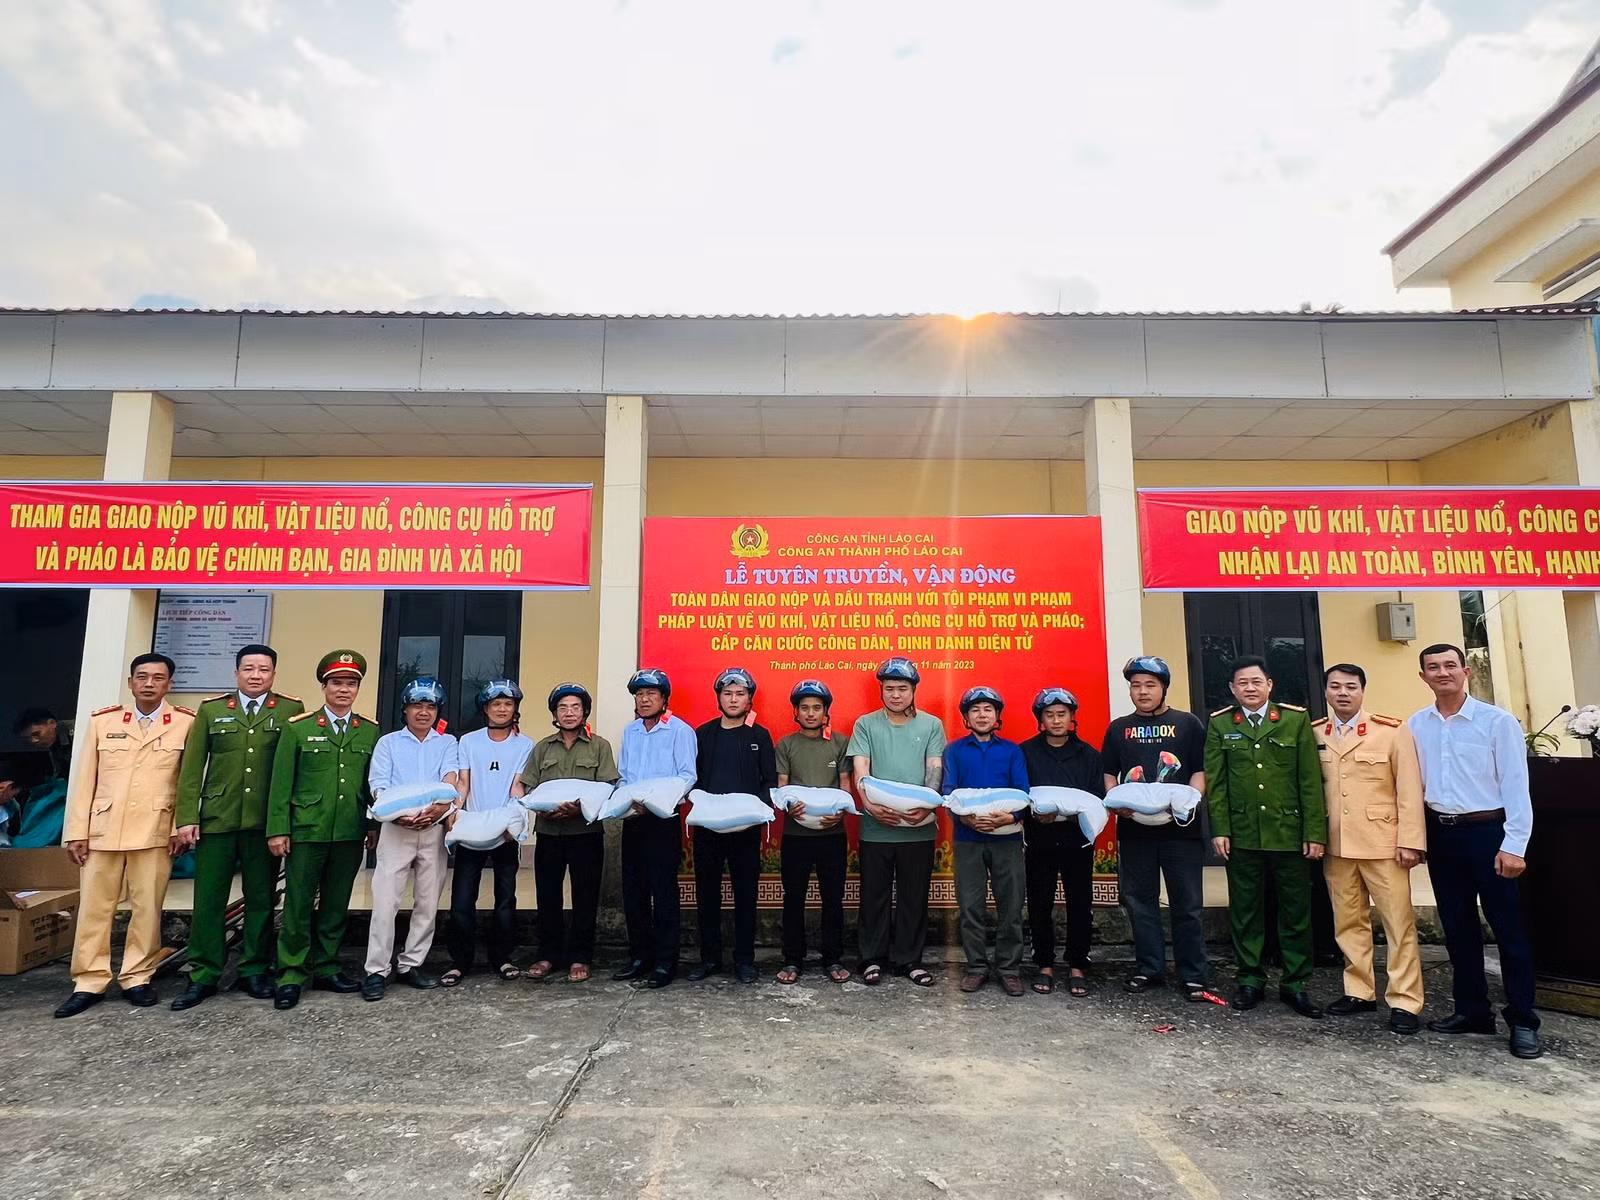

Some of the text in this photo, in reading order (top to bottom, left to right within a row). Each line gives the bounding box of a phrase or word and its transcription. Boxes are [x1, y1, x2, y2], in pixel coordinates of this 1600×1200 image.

[11, 497, 555, 536] THAM GIA GIAO NỘP VŨ KHÍ, VẬT LIỆU NỔ, CÔNG CỤ HỖ TRỢ
[1186, 500, 1600, 538] GIAO NỘP VŨ KHÍ, VẬT LIỆU NỔ, CÔNG C
[806, 532, 934, 543] CÔNG AN TỈNH LÀO CAI
[37, 537, 521, 578] VÀ PHÁO LÀ BẢO VỆ CHÍNH BẠN, GIA ĐÌNH VÀ XÃ HỘI
[778, 544, 962, 556] CÔNG AN THÀNH PHỐ LÀO CAI
[725, 561, 1016, 587] LỄ TUYÊN TRUYỀN, VẬN ĐỘNG
[1219, 546, 1600, 580] NHẬN LẠI AN TOÀN, BÌNH YÊN, HẠNH
[671, 588, 1071, 609] TOÀN DÂN GIAO NỘP VÀ ĐẤU TRANH VỚI TỘI PHẠM VI PHẠM
[659, 609, 1084, 632] PHÁP LUẬT VỀ VŨ KHÍ, VẬT LIỆU NỔ, CÔNG CỤ HỖ TRỢ VÀ PHÁO;
[712, 631, 1033, 652] CẤP CĂN CƯỚC CÔNG DÂN, ĐỊNH DANH ĐIỆN TỬ
[770, 661, 797, 670] Thành
[799, 661, 816, 672] phố
[818, 661, 836, 670] Lào
[837, 661, 854, 671] Cai,
[856, 661, 878, 671] ngày
[921, 661, 930, 669] 11
[932, 661, 952, 670] năm
[954, 661, 974, 670] 2023
[1125, 725, 1176, 739] PARADOX
